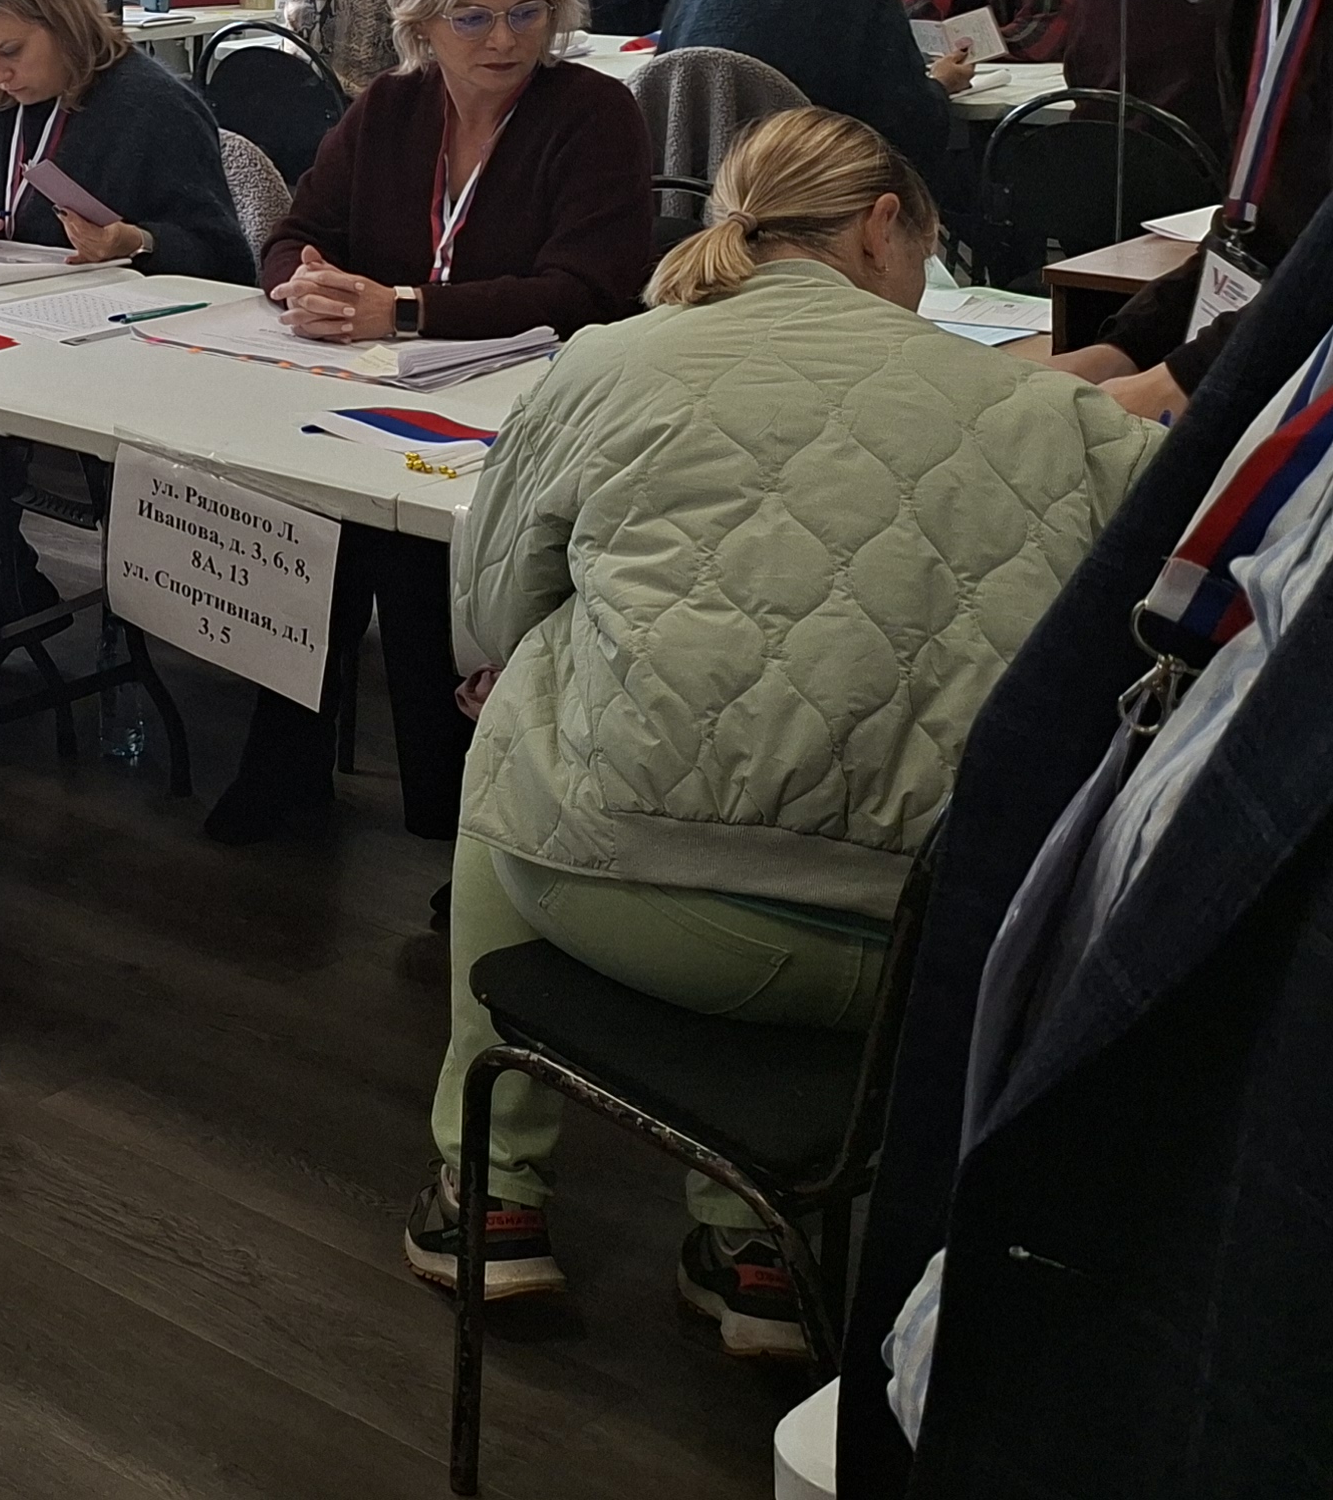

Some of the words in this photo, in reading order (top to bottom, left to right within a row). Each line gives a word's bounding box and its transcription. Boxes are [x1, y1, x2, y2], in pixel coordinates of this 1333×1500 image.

[137, 499, 225, 550] Иванова,
[228, 538, 246, 556] д.
[251, 542, 268, 566] 3,
[273, 551, 290, 576] 6,
[294, 558, 311, 584] 8,
[152, 477, 179, 500] ул.
[185, 485, 273, 534] Рядового
[277, 521, 300, 545] Л.
[191, 550, 223, 581] 8А,
[229, 564, 250, 588] 13
[123, 560, 149, 583] ул.
[154, 570, 278, 637] Спортивная,
[281, 627, 316, 653] д.1,
[198, 617, 215, 642] 3,
[220, 626, 232, 645] 5
